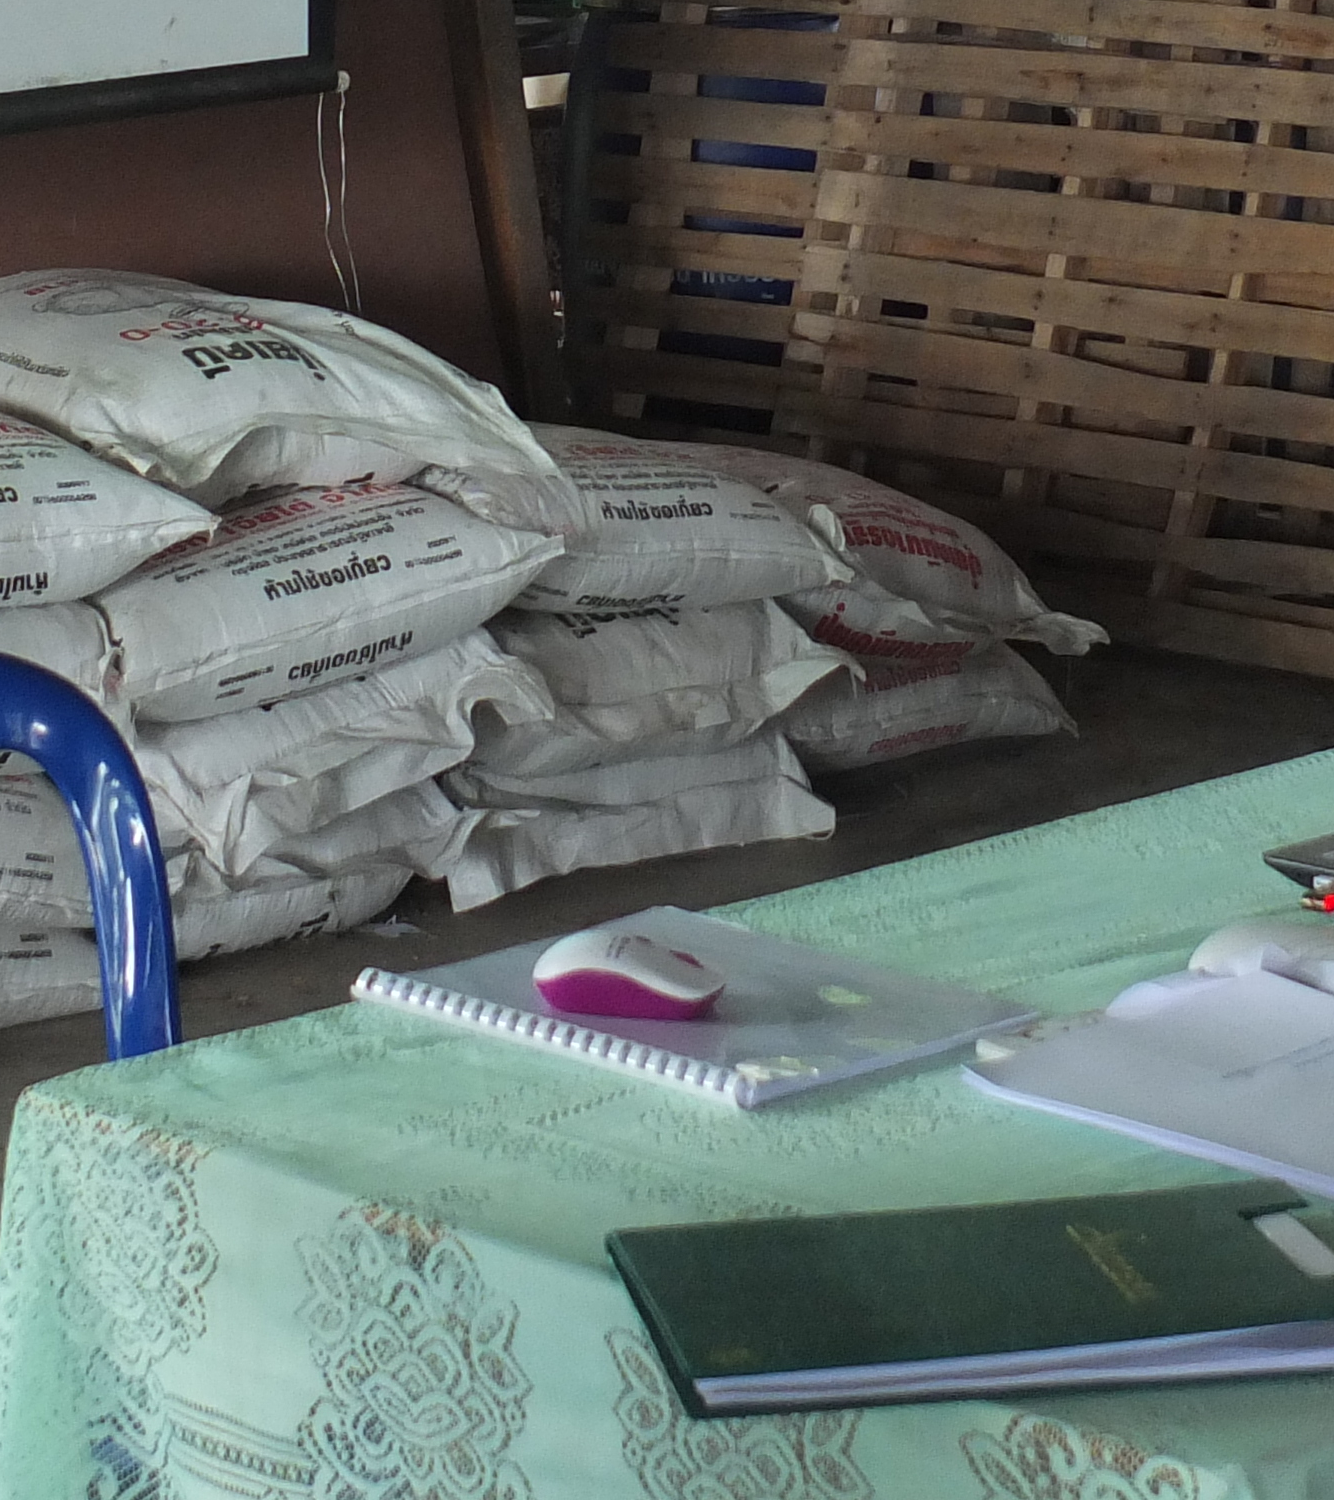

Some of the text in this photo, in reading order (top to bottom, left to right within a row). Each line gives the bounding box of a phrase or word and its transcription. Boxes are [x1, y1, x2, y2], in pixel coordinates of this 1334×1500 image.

[263, 551, 392, 601] ห้ามใช้ขอเกี่ยว
